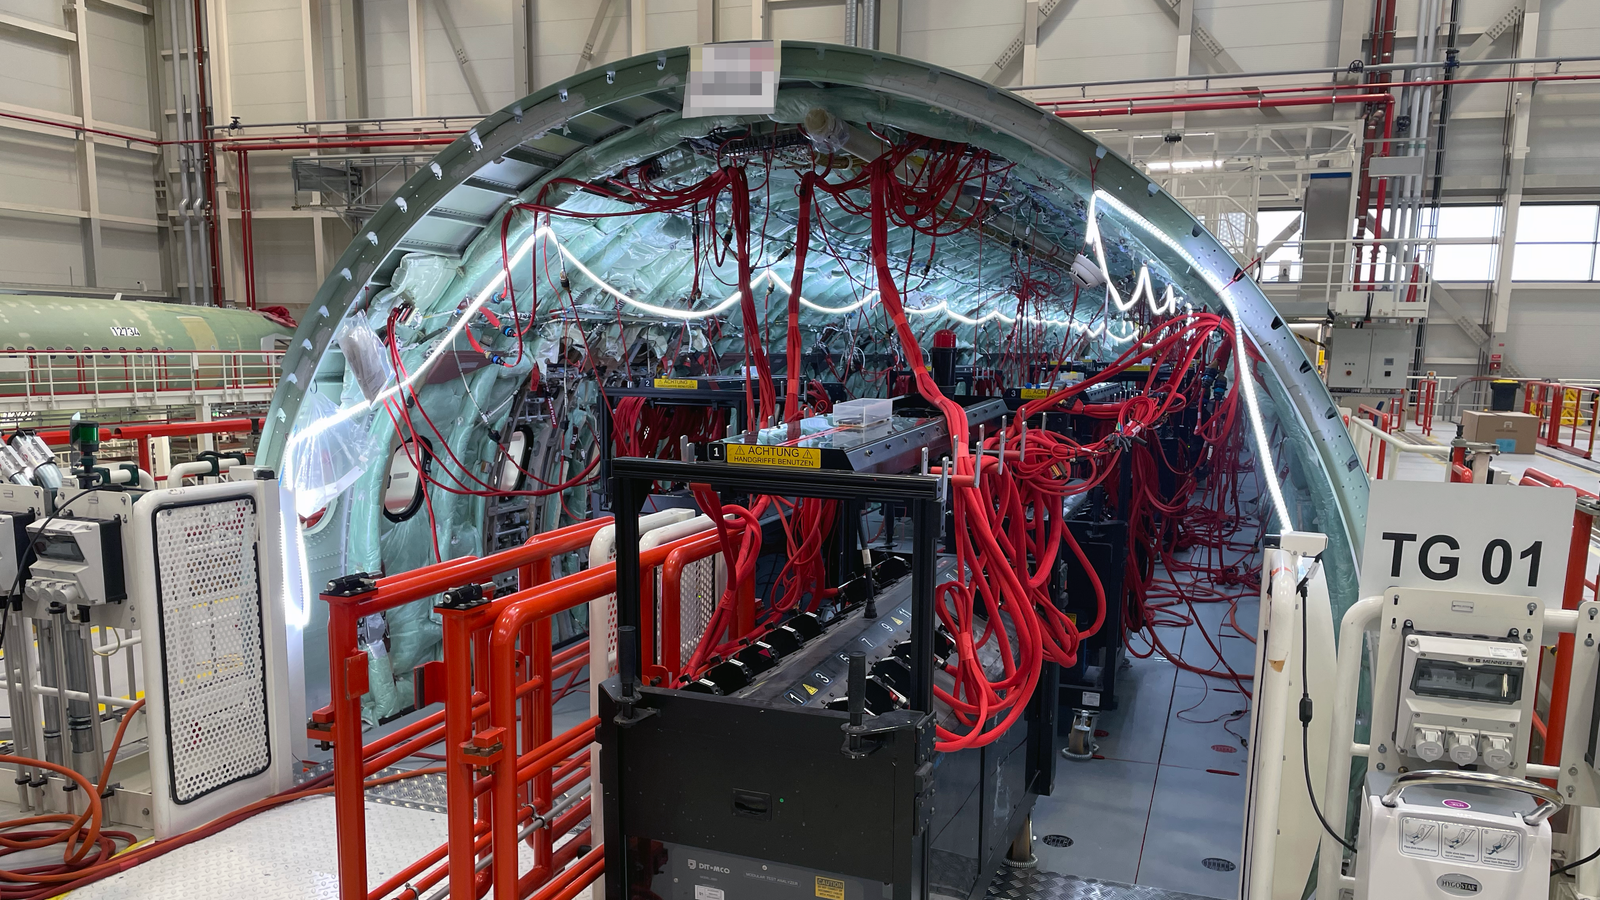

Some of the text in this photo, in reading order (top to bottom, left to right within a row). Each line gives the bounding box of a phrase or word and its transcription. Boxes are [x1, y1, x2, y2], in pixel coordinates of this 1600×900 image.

[110, 326, 141, 337] 12734
[713, 447, 720, 457] 1
[748, 446, 800, 457] ACHTUNG
[734, 456, 814, 467] HANDGRIFFE BENUTZEN
[1382, 532, 1543, 587] TG 01
[880, 622, 893, 632] 9
[861, 637, 874, 648] 7
[815, 672, 830, 683] 3
[789, 692, 804, 704] 1
[776, 878, 799, 886] ANALYZER
[817, 878, 844, 888] CAUTION
